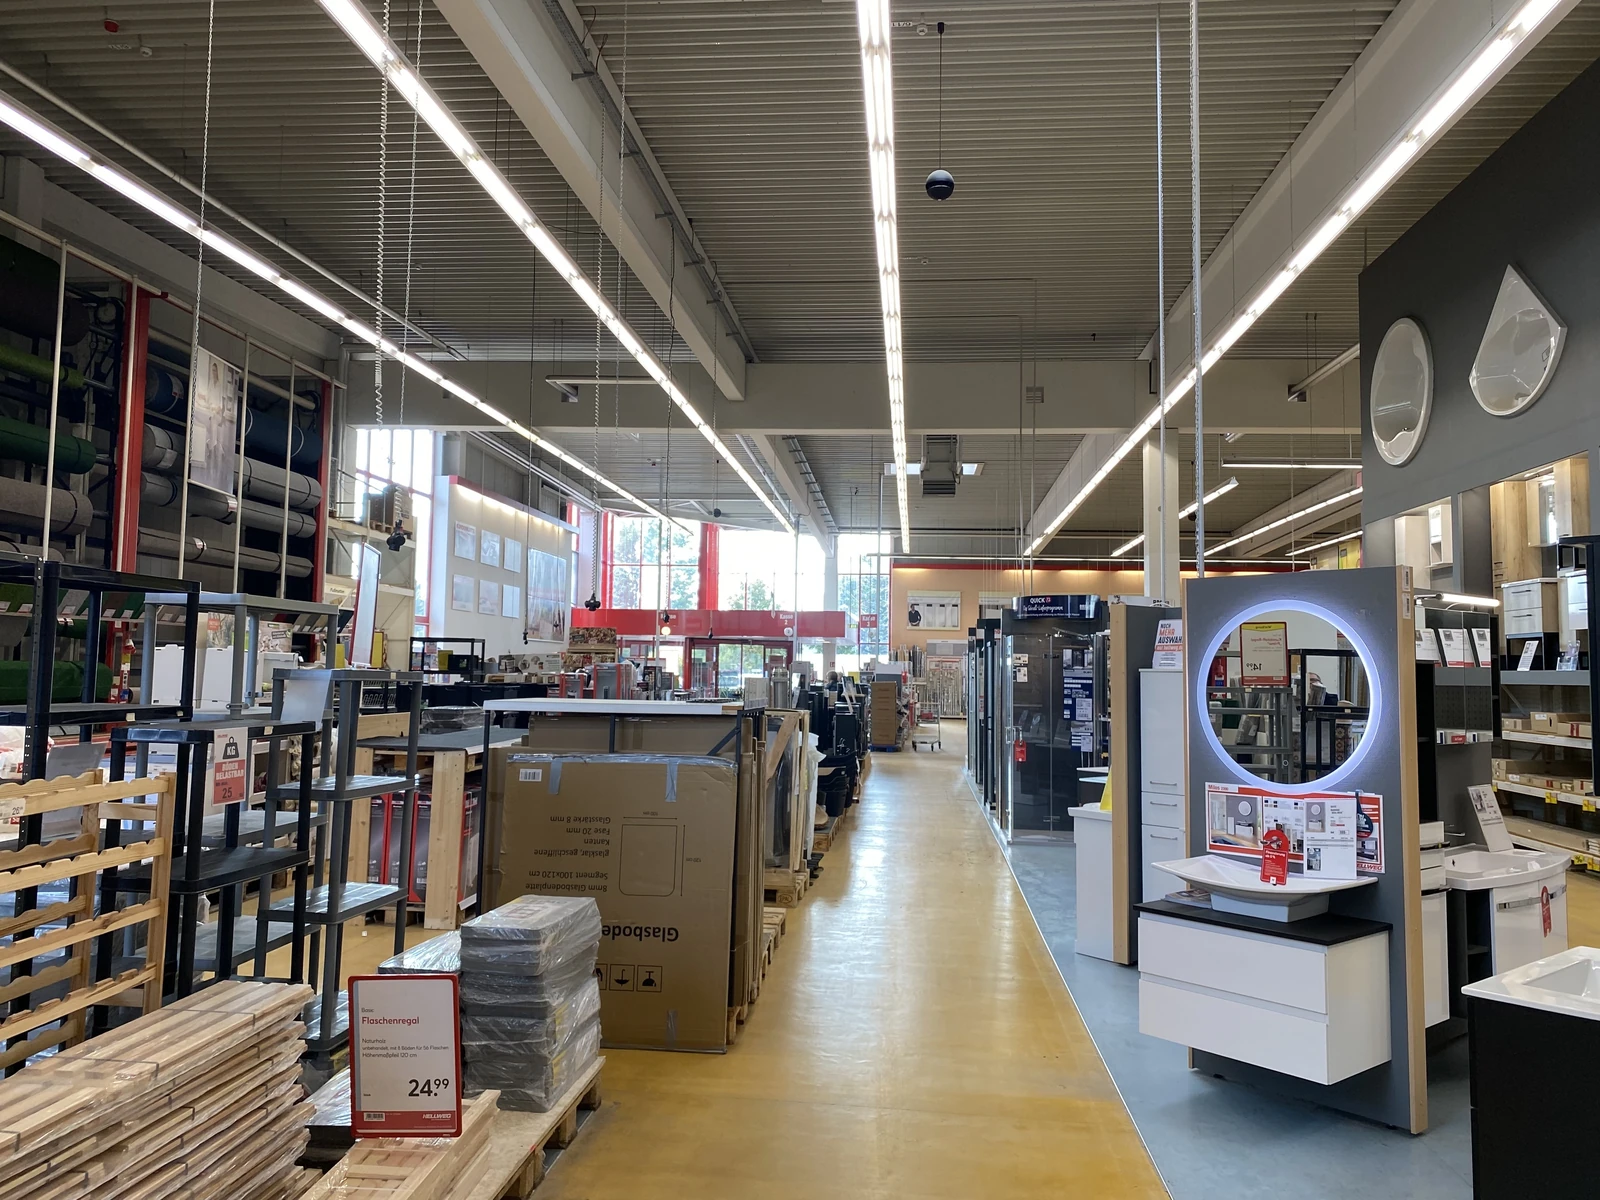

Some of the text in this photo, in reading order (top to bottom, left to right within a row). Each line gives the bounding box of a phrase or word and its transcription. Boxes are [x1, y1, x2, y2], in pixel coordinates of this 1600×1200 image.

[227, 746, 235, 755] KG
[222, 762, 238, 771] BÖDEN
[216, 770, 244, 780] BELASTBAR
[222, 787, 232, 798] 25
[579, 849, 609, 857] glasklar,
[575, 870, 608, 879] Segment
[525, 883, 586, 892] Glasbodenplatte
[602, 925, 679, 942] Glasbode
[362, 1016, 419, 1026] Flaschenregal
[408, 1078, 449, 1097] 24.99
